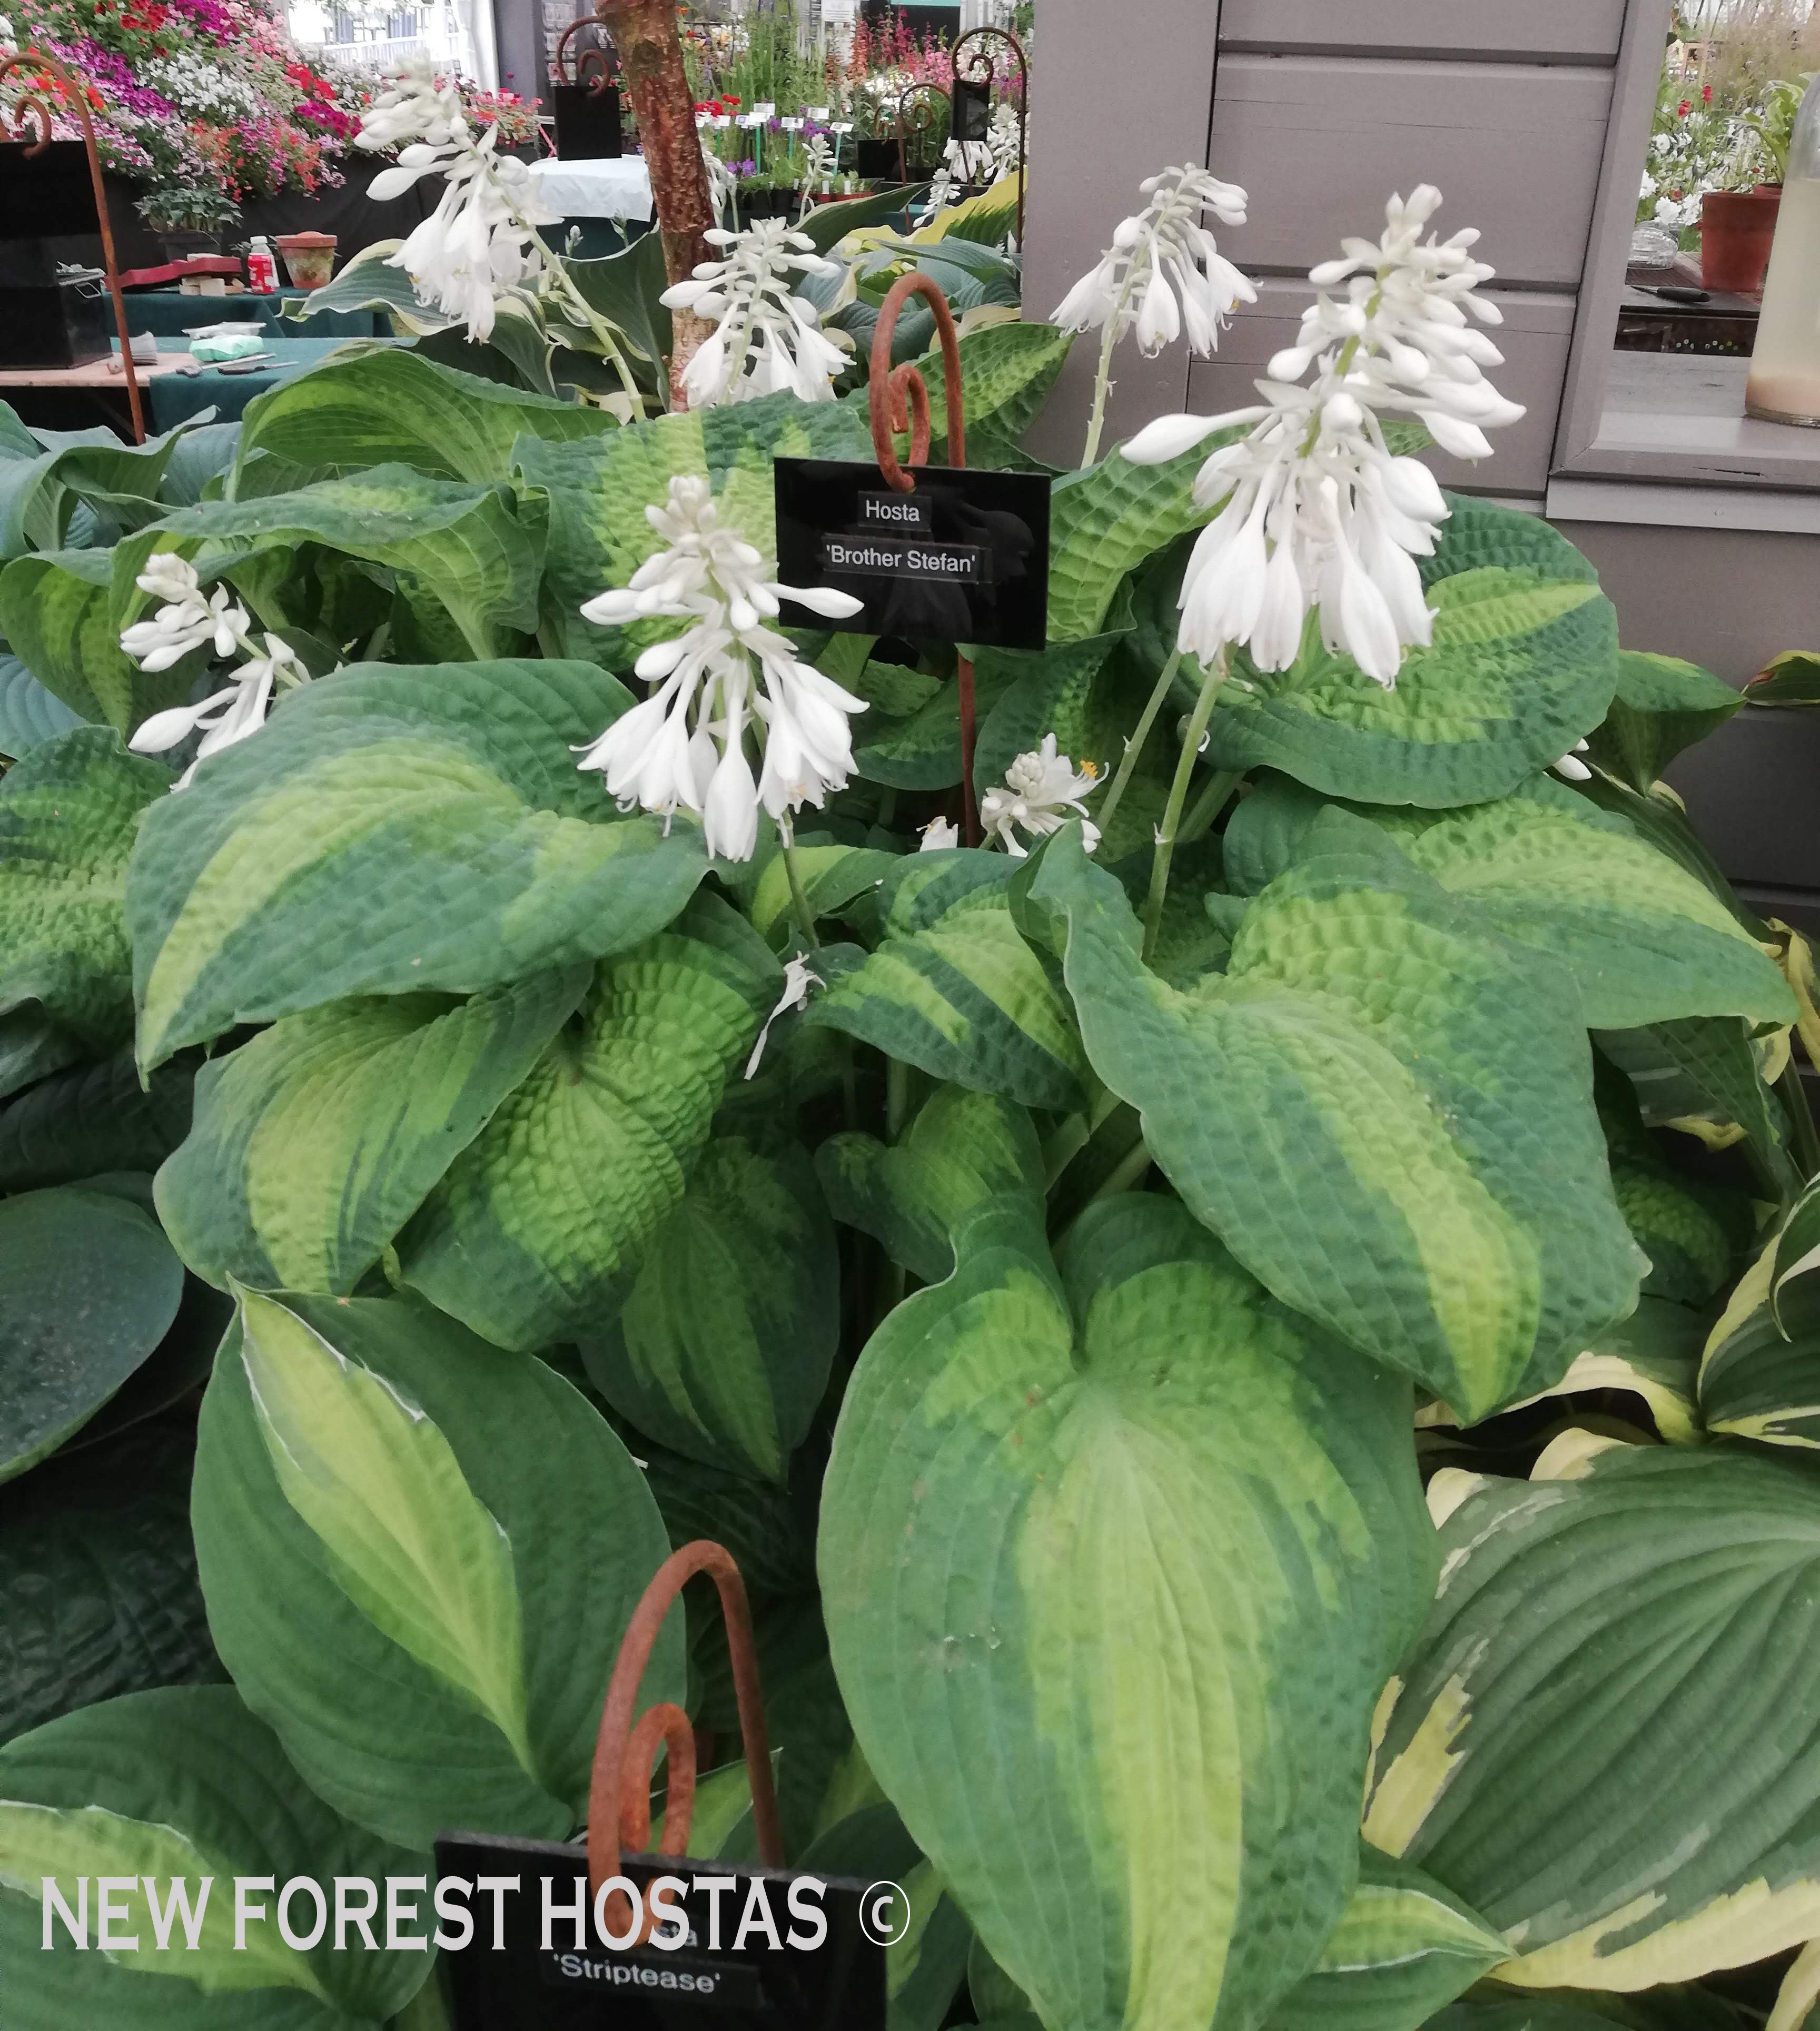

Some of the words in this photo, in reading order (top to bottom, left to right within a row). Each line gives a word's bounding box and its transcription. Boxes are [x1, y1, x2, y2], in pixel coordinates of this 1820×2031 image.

[865, 500, 920, 522] Hosta
[826, 544, 902, 568] 'Brother
[907, 549, 976, 573] Stefan'
[552, 1953, 721, 1994] 'Striptease'
